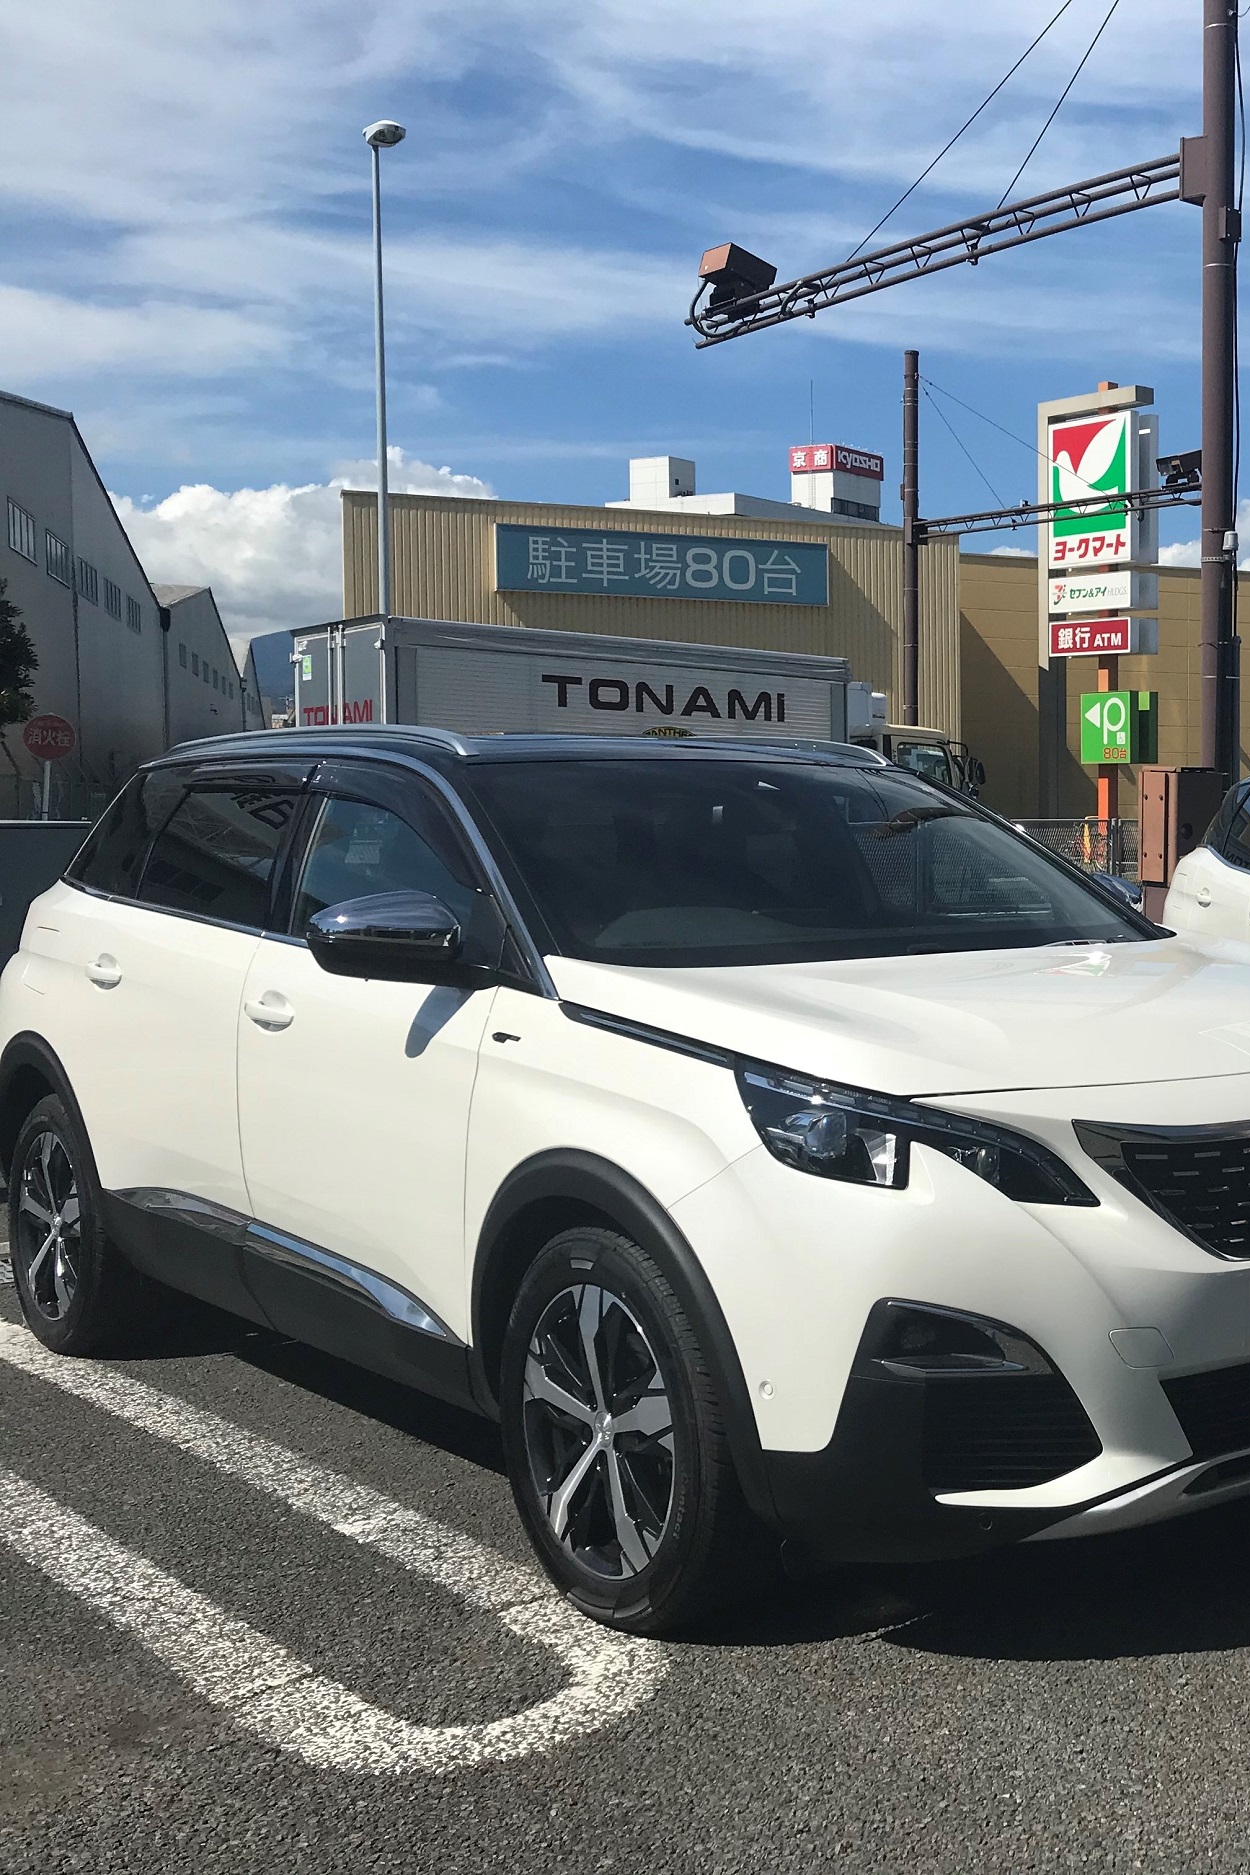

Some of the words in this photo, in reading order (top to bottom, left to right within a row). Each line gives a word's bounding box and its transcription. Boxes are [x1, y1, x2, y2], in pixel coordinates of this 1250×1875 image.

[792, 450, 828, 468] 京商
[1053, 533, 1126, 561] ヨークマート
[527, 536, 801, 596] 駐車場80台
[1103, 698, 1126, 745] P
[28, 728, 71, 747] 消火栓
[1103, 747, 1127, 760] 80台
